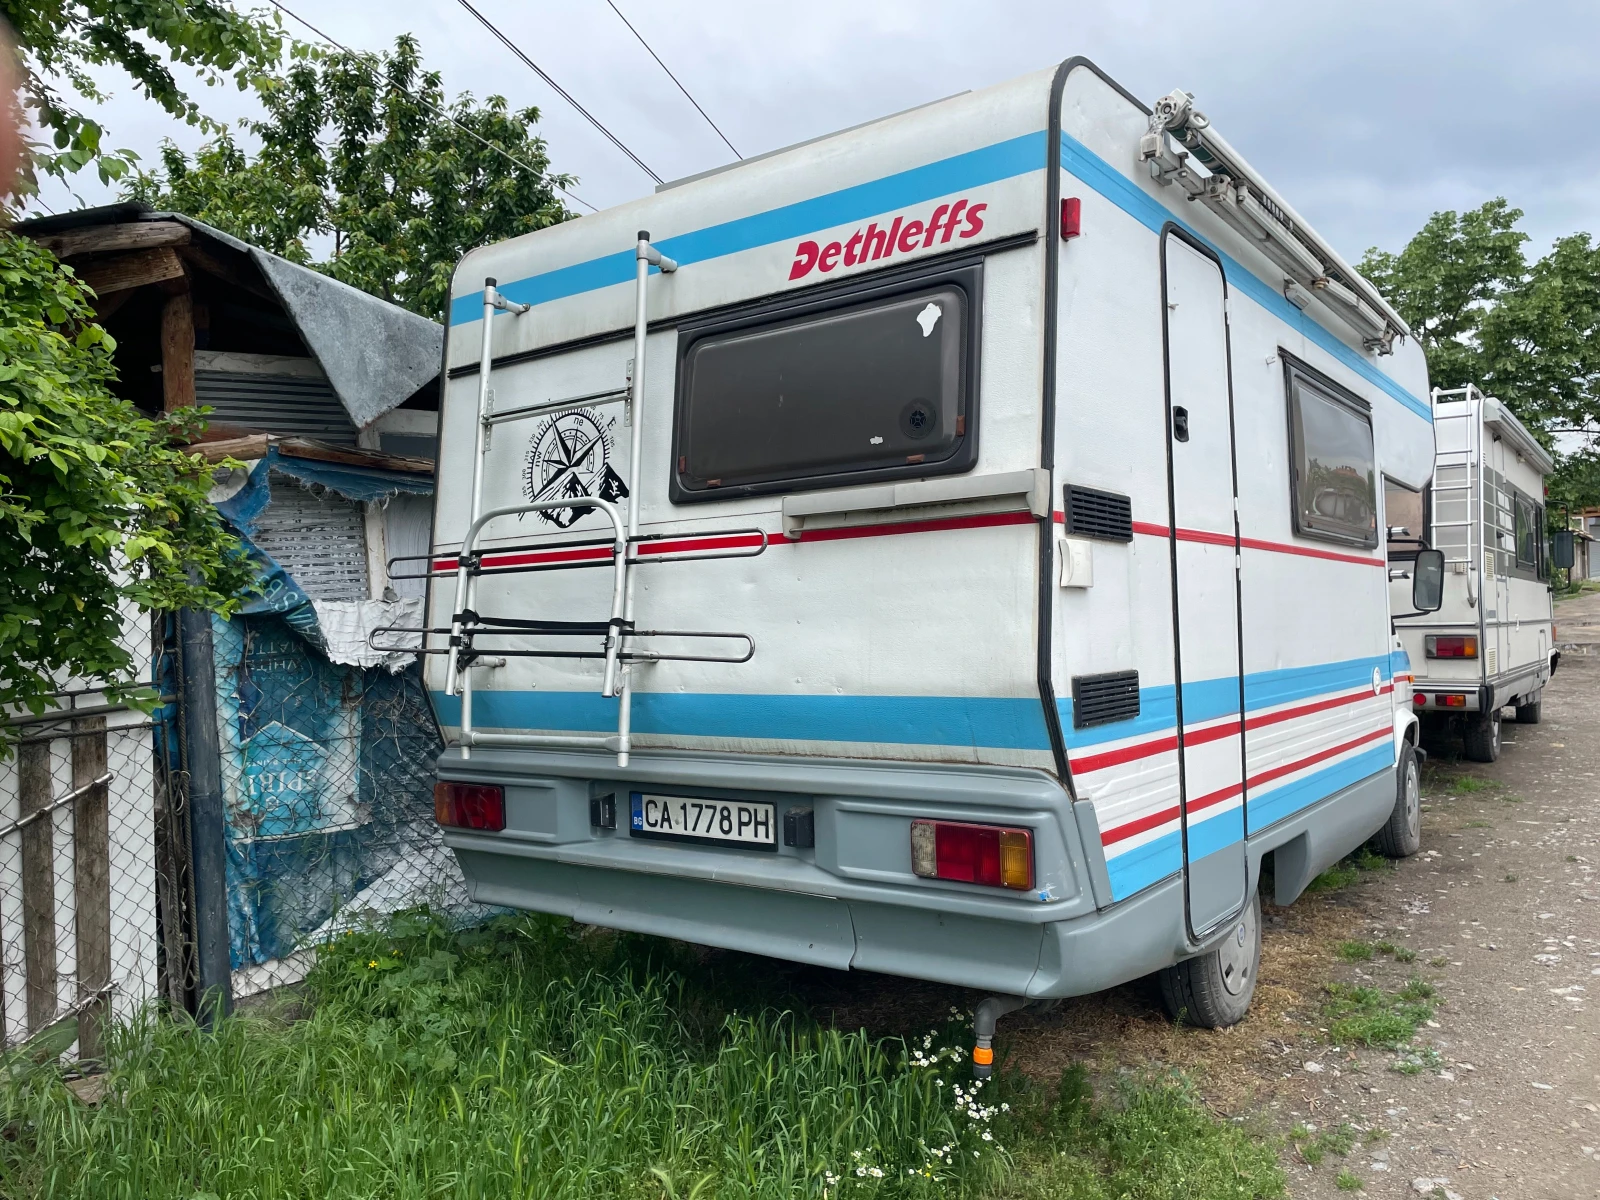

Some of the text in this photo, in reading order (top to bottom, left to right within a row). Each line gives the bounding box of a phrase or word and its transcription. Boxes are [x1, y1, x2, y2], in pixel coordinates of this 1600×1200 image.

[788, 199, 988, 281] Dethleffs
[573, 416, 584, 427] ne
[607, 415, 617, 431] E
[633, 816, 643, 825] BG
[645, 800, 770, 839] CA 1778 PH
